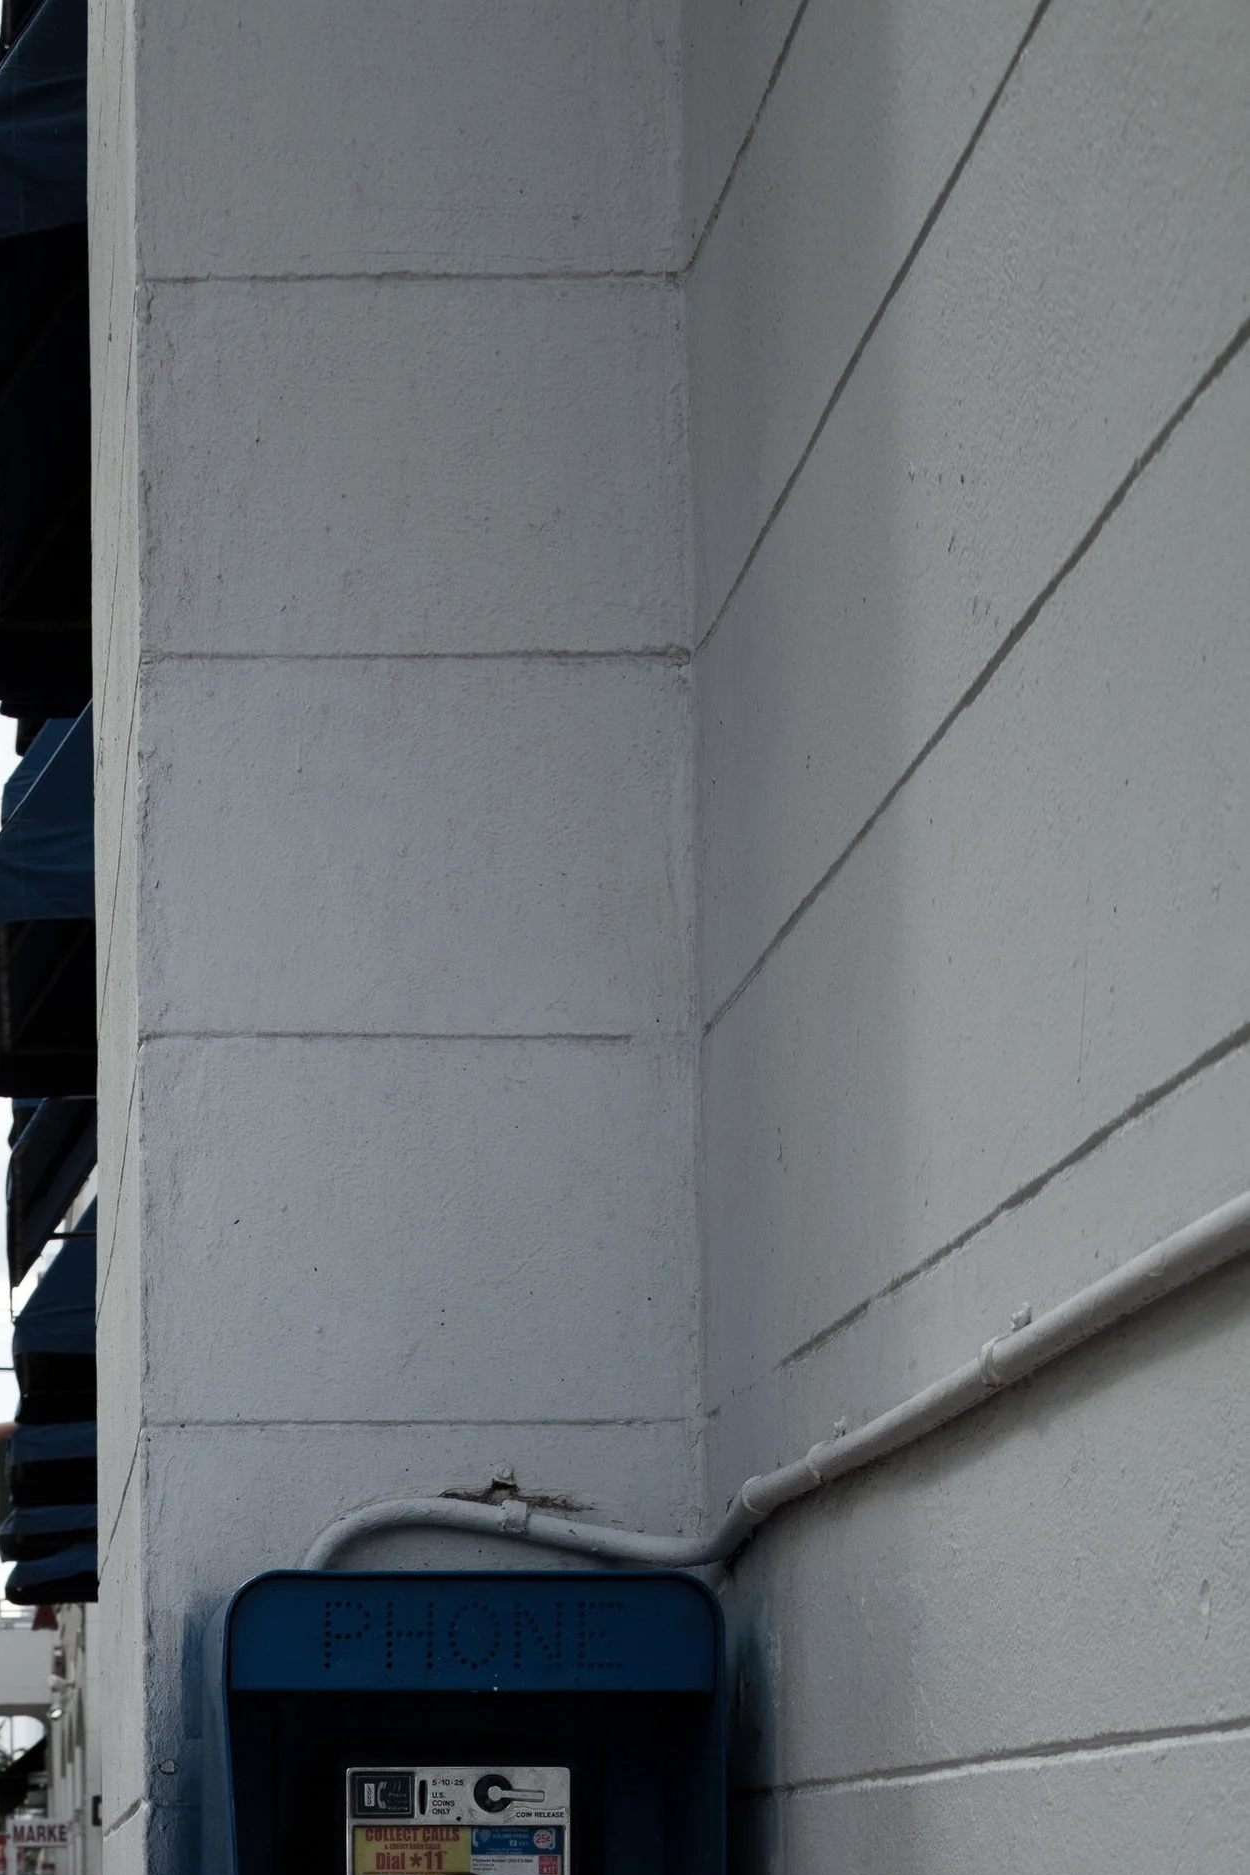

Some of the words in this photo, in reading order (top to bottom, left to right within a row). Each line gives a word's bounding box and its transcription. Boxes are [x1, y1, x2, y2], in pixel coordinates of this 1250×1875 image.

[324, 1600, 626, 1670] PHONE
[432, 1808, 451, 1816] ONLY
[536, 1811, 565, 1819] RELEASE
[365, 1827, 418, 1842] COLLECT
[422, 1827, 460, 1842] CALLS
[376, 1852, 405, 1870] Dial
